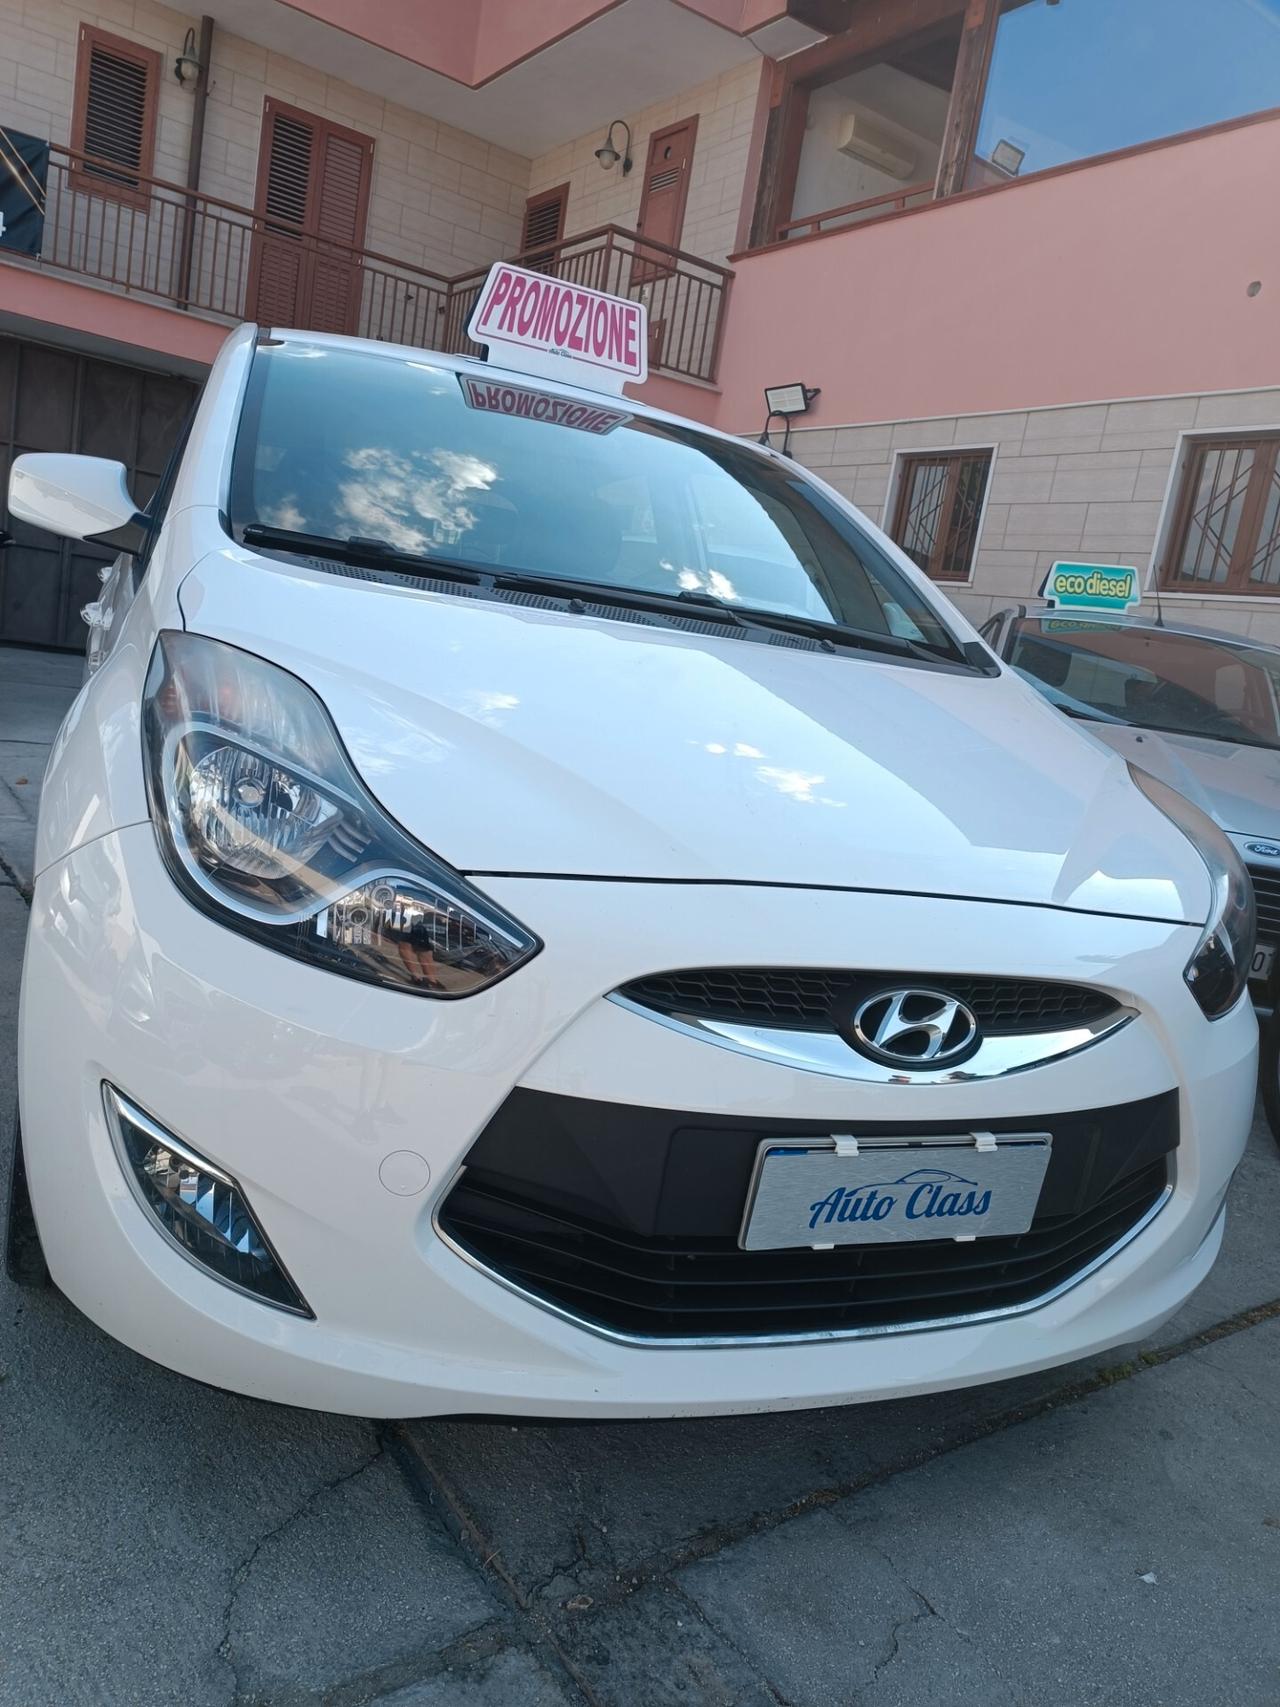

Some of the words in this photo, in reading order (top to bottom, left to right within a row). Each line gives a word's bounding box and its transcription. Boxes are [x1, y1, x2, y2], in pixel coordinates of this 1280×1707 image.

[481, 271, 637, 367] PROMOZIONE
[808, 1186, 898, 1229] Auto
[905, 1183, 992, 1220] Class
